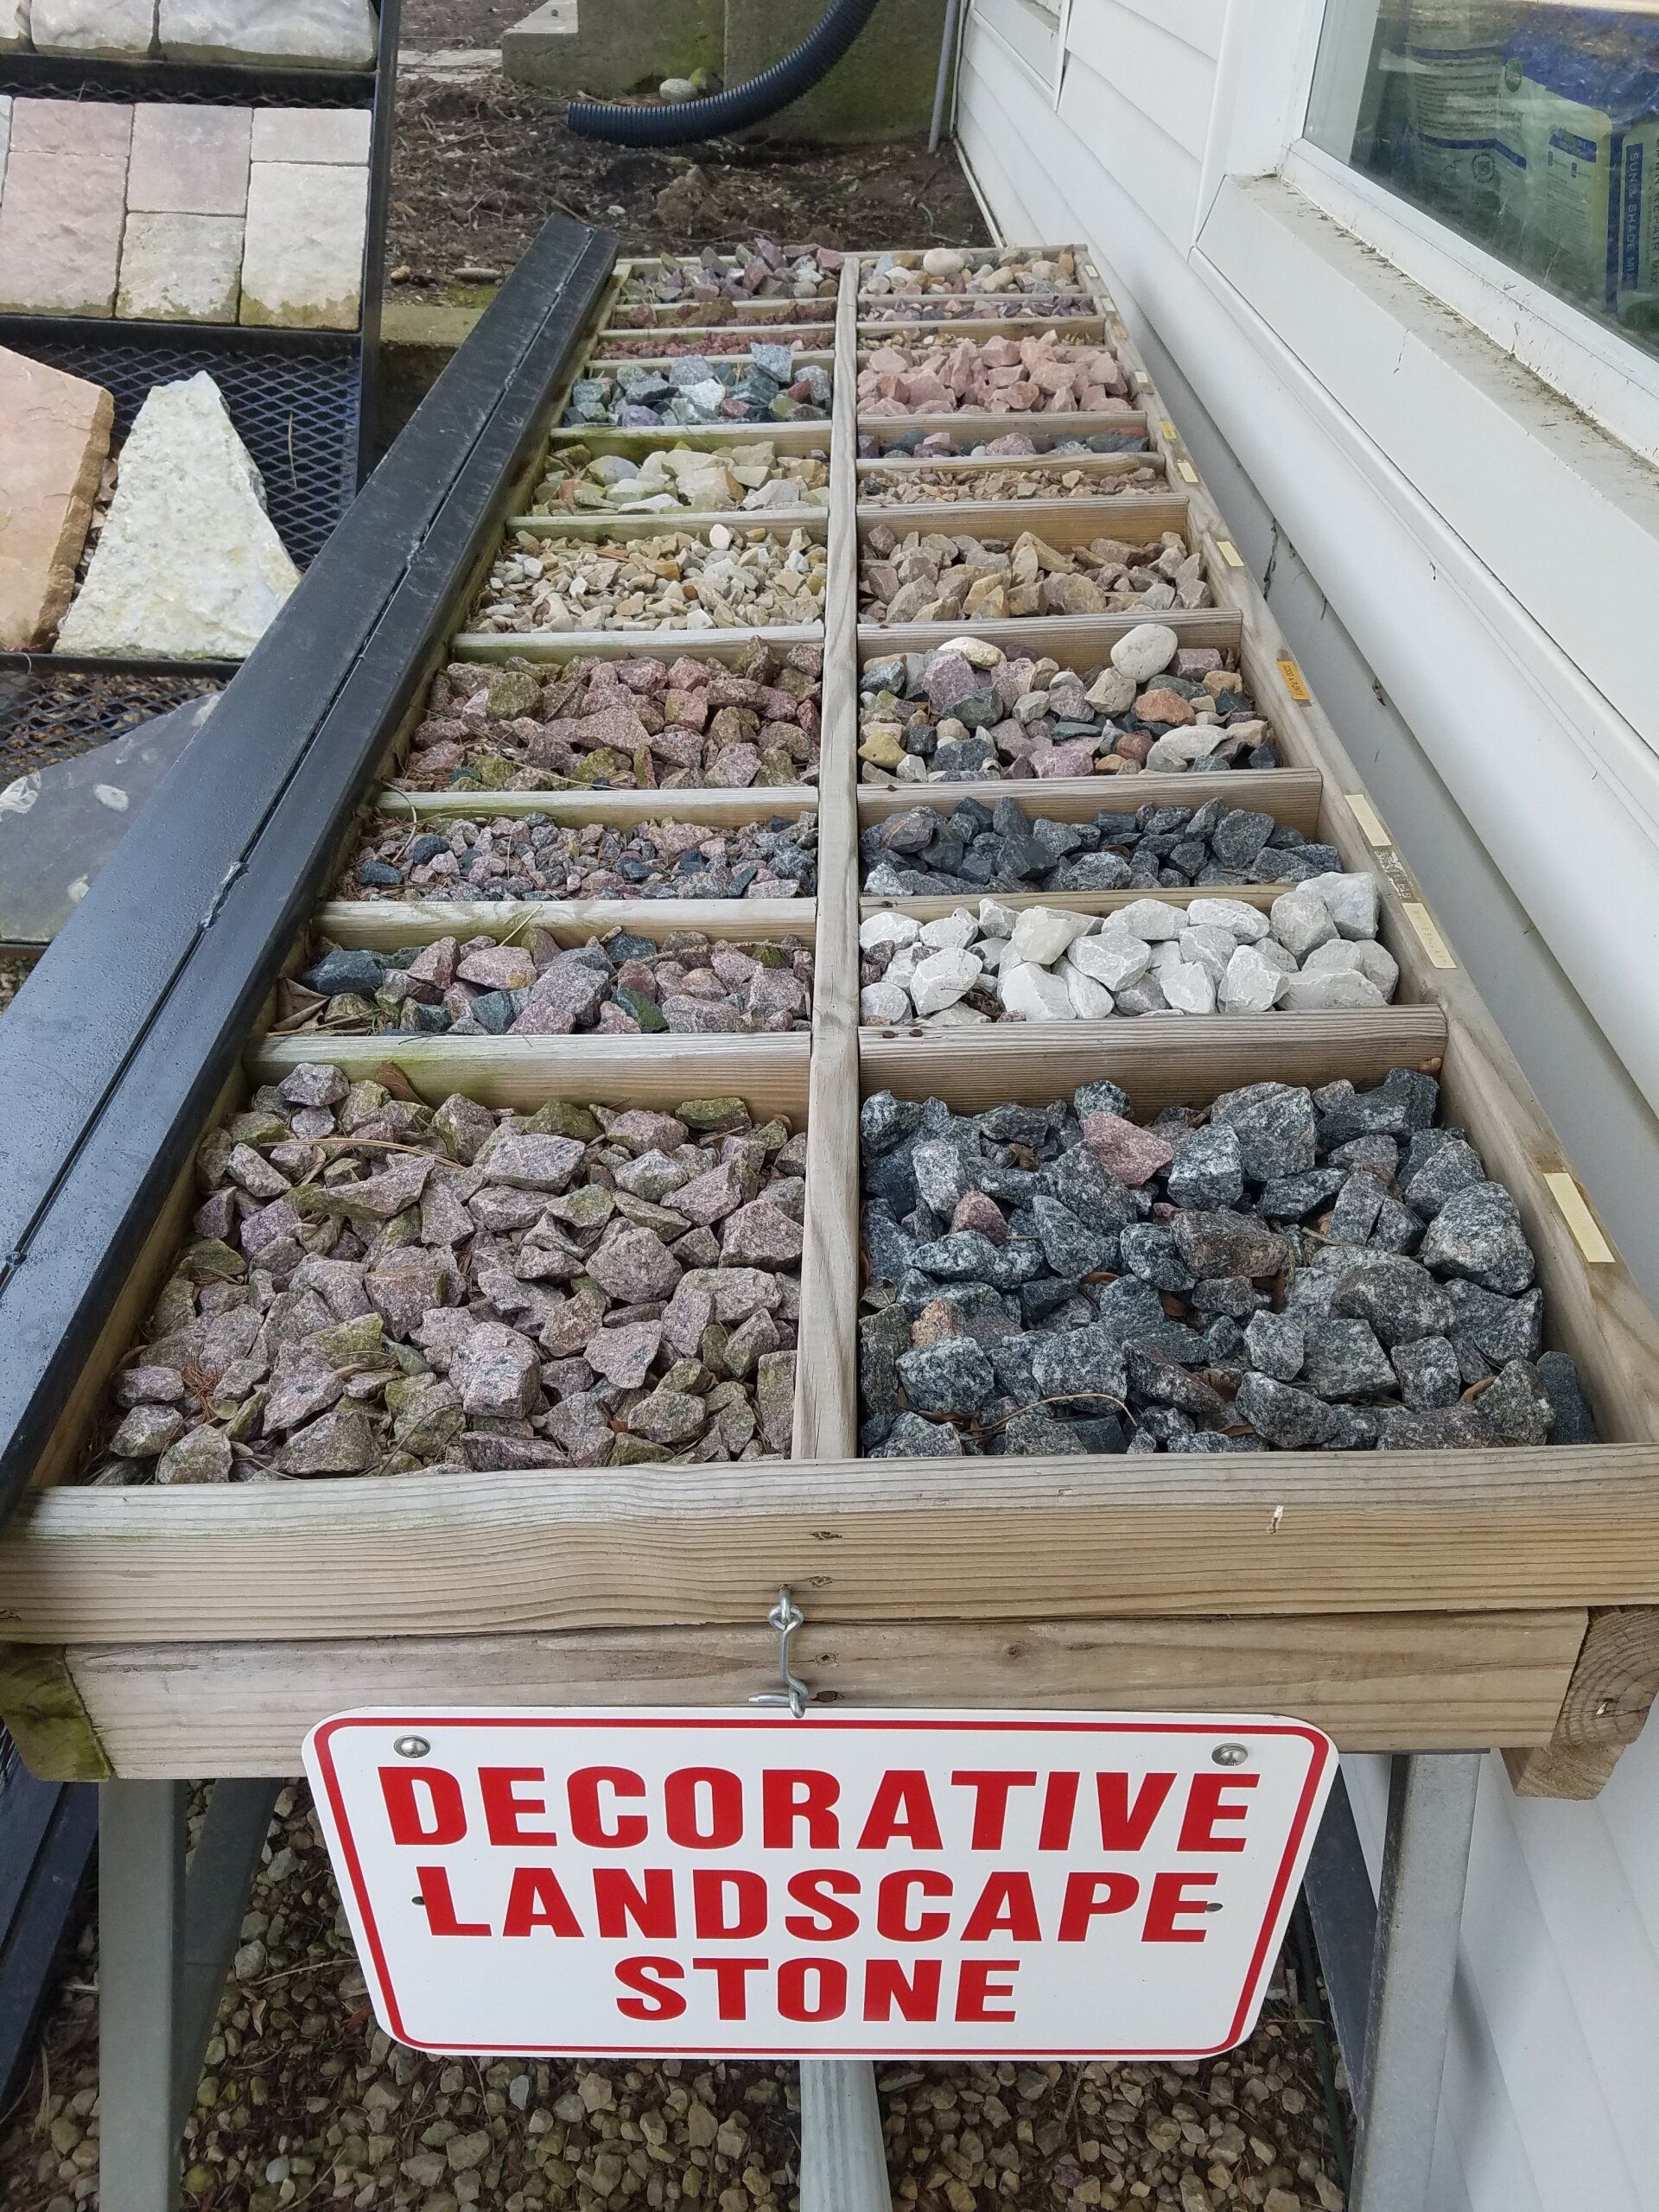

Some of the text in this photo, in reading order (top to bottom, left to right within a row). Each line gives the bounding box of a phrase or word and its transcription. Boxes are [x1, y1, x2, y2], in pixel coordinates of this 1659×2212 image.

[1628, 152, 1638, 182] SUN
[1628, 188, 1637, 199] &
[1626, 203, 1637, 252] SHADE
[378, 1767, 1258, 1852] DECORATIVE
[417, 1866, 1217, 1942] LANDSCAPE
[615, 1957, 1019, 2021] STONE
